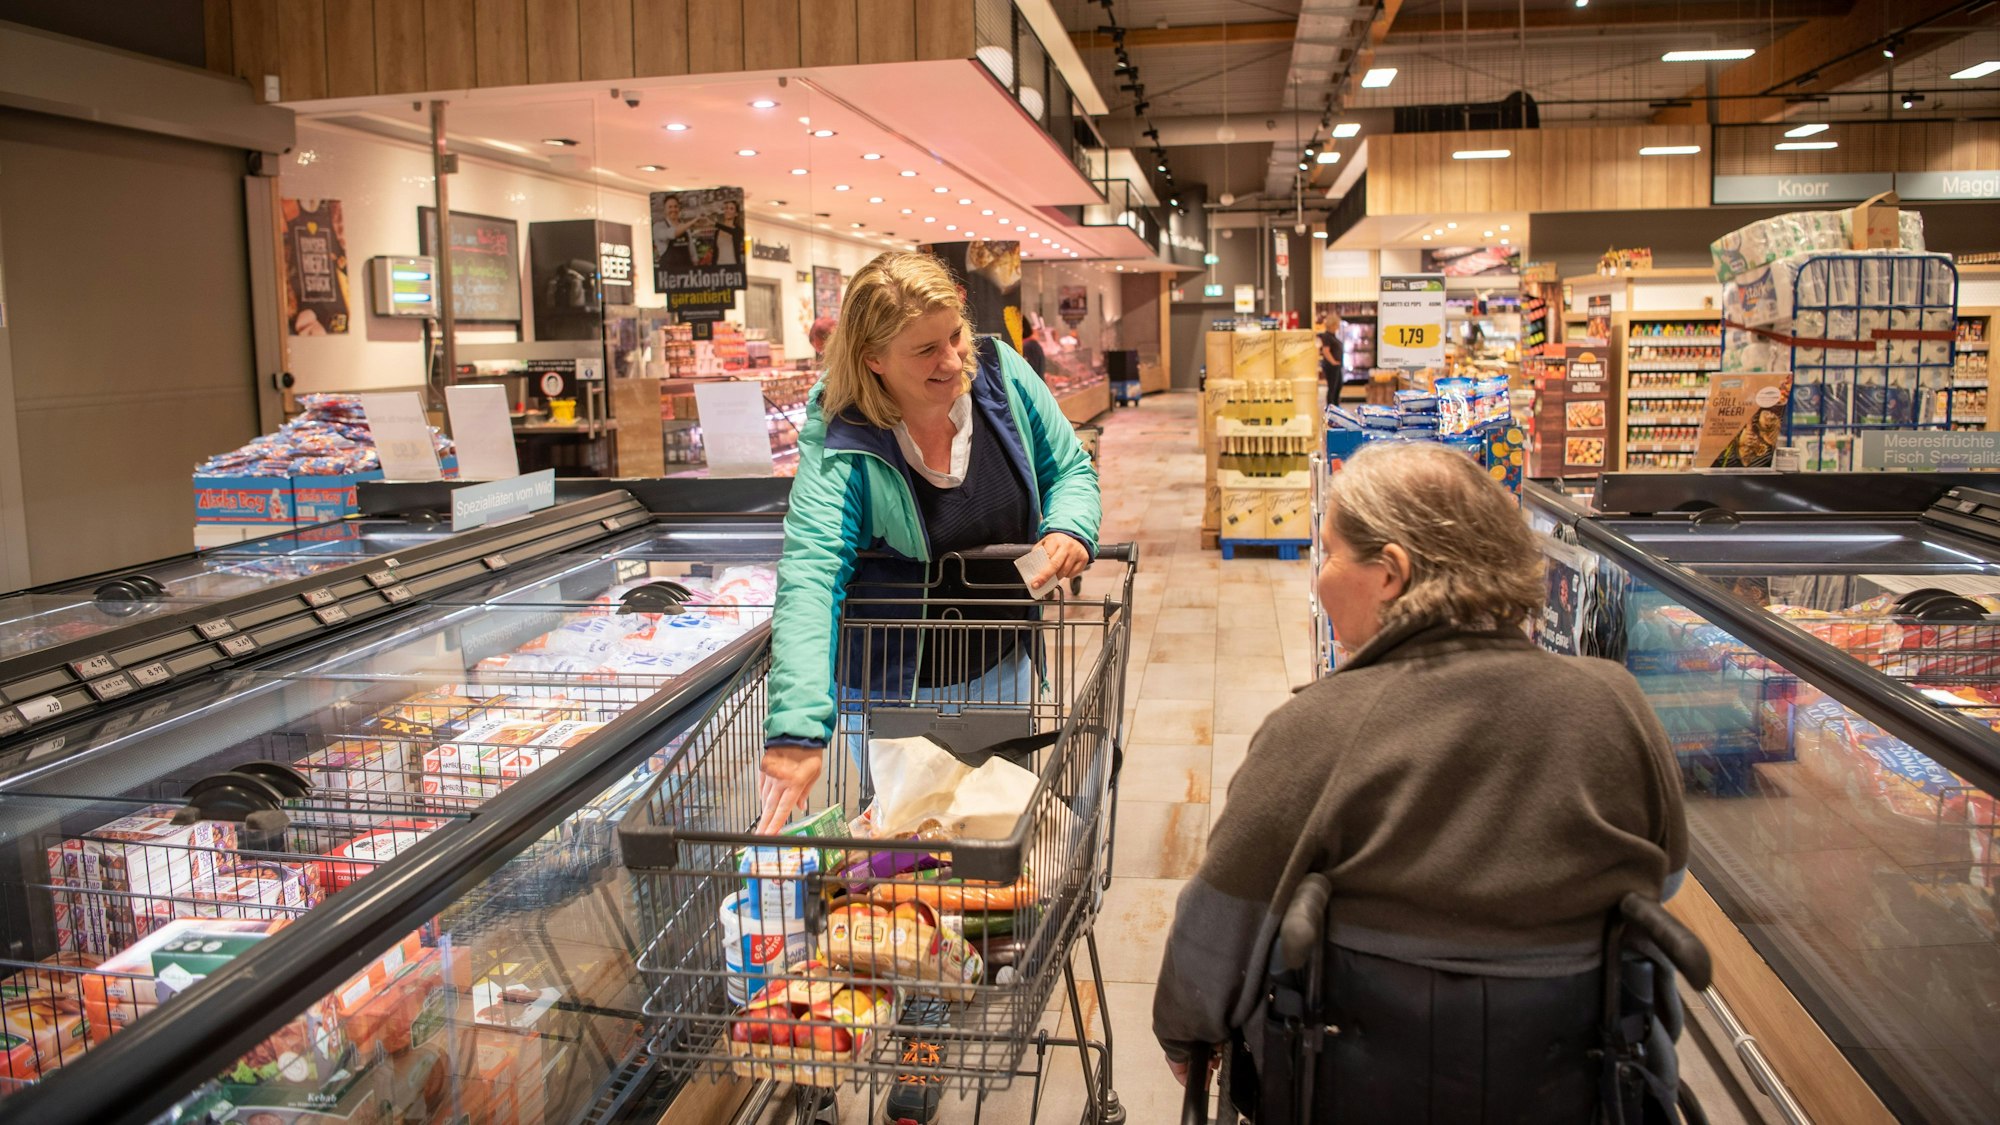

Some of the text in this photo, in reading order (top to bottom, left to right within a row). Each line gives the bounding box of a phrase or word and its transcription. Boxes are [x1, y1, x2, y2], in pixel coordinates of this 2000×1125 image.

[1778, 180, 1829, 196] Knorr
[1943, 176, 1999, 195] Maggi
[614, 244, 630, 257] AGED
[602, 256, 630, 279] BEEF
[658, 270, 743, 290] Herzklopfen
[671, 289, 731, 308] garantiert!
[1399, 328, 1424, 346] 1,79
[1712, 397, 1737, 407] GRILL
[1884, 434, 1994, 448] Meeresfrüchte
[1884, 450, 2000, 465] Fisch Spezialitä
[199, 489, 266, 513] Alaska Boy
[296, 489, 320, 504] Alaska
[320, 490, 342, 505] Boy
[456, 479, 552, 518] Spezialitäten vom Wild
[46, 702, 60, 713] 2,19
[442, 763, 472, 773] HAMBURGER
[1888, 746, 1926, 778] LONGS
[308, 1092, 338, 1102] Kebab
